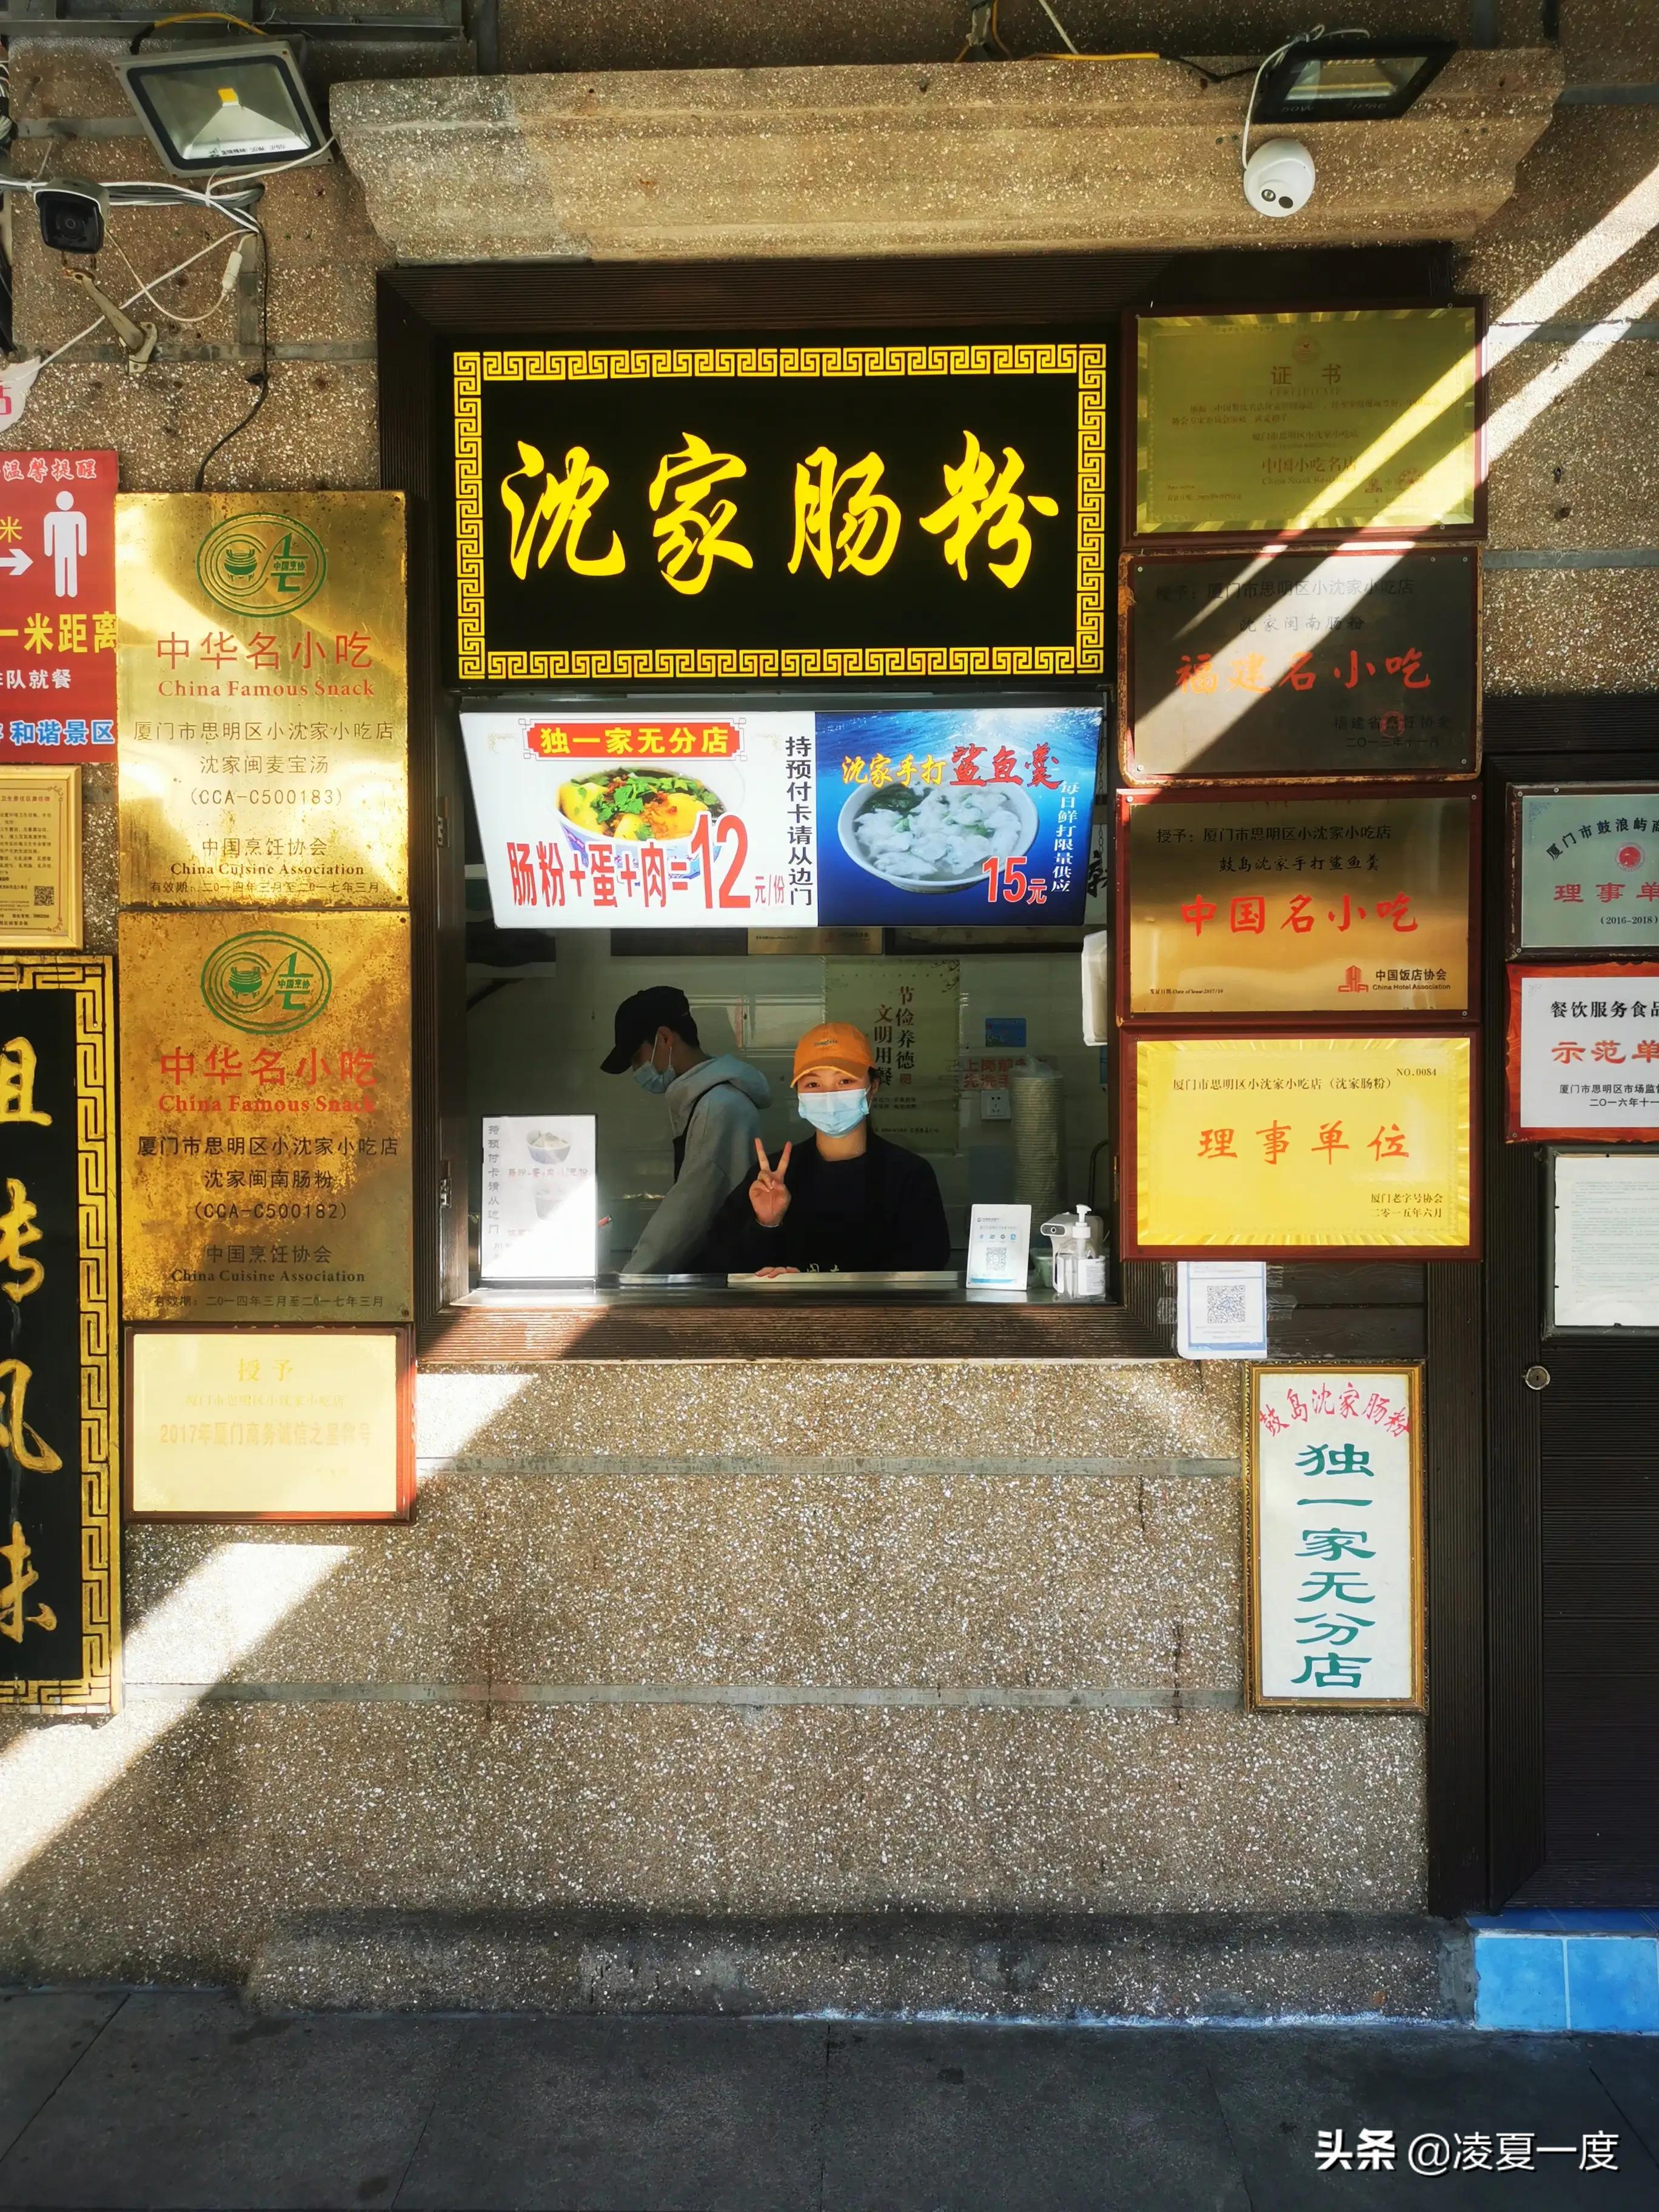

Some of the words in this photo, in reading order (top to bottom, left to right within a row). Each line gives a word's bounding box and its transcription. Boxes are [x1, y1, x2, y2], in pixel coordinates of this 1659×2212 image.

[2, 457, 97, 483] 温馨提醒
[501, 430, 1059, 595] 沈家肠粉
[156, 631, 373, 670] 中华名小吃
[0, 669, 72, 689] 队就餐
[1175, 647, 1431, 695] 福建名小吃
[158, 680, 221, 697] China
[228, 679, 308, 697] Famous
[314, 678, 375, 697] Snack
[133, 720, 395, 741] 厦门市思明区小沈家小吃店
[540, 726, 729, 754] 独一家无分店
[200, 755, 329, 775] 沈家闽麦宝汤
[785, 736, 813, 906] 持预付卡请从边门
[202, 837, 327, 857] 中国烹饪协会
[1051, 781, 1079, 893] 每日鲜打限量供应
[170, 863, 214, 876] China
[280, 863, 364, 876] Association
[982, 856, 1048, 905] 15元
[1181, 891, 1419, 937] 中国名小吃
[1375, 968, 1447, 981] 中国饭店协会
[895, 985, 916, 1070] 节俭养德
[874, 1004, 893, 1087] 文明用餐
[1551, 1040, 1659, 1064] 示范单
[160, 1045, 378, 1087] 中华名小吃
[159, 1094, 222, 1113] China
[228, 1094, 310, 1113] Famous
[315, 1094, 377, 1113] Snack
[137, 1136, 398, 1156] 厦门市思明区小沈家小吃店
[1197, 1119, 1410, 1165] 理事单位
[204, 1169, 333, 1189] 沈家闽南肠粉
[1370, 1193, 1443, 1204] 厦门老字号协会
[206, 1244, 332, 1264] 中国烹饪协会
[171, 1269, 215, 1282] China
[219, 1269, 275, 1282] Cuisine
[280, 1269, 365, 1282] Association
[238, 1358, 293, 1382] 授予
[1259, 1382, 1410, 1438] 鼓岛沈家肠粉
[1290, 1443, 1376, 1689] 独一家无分店
